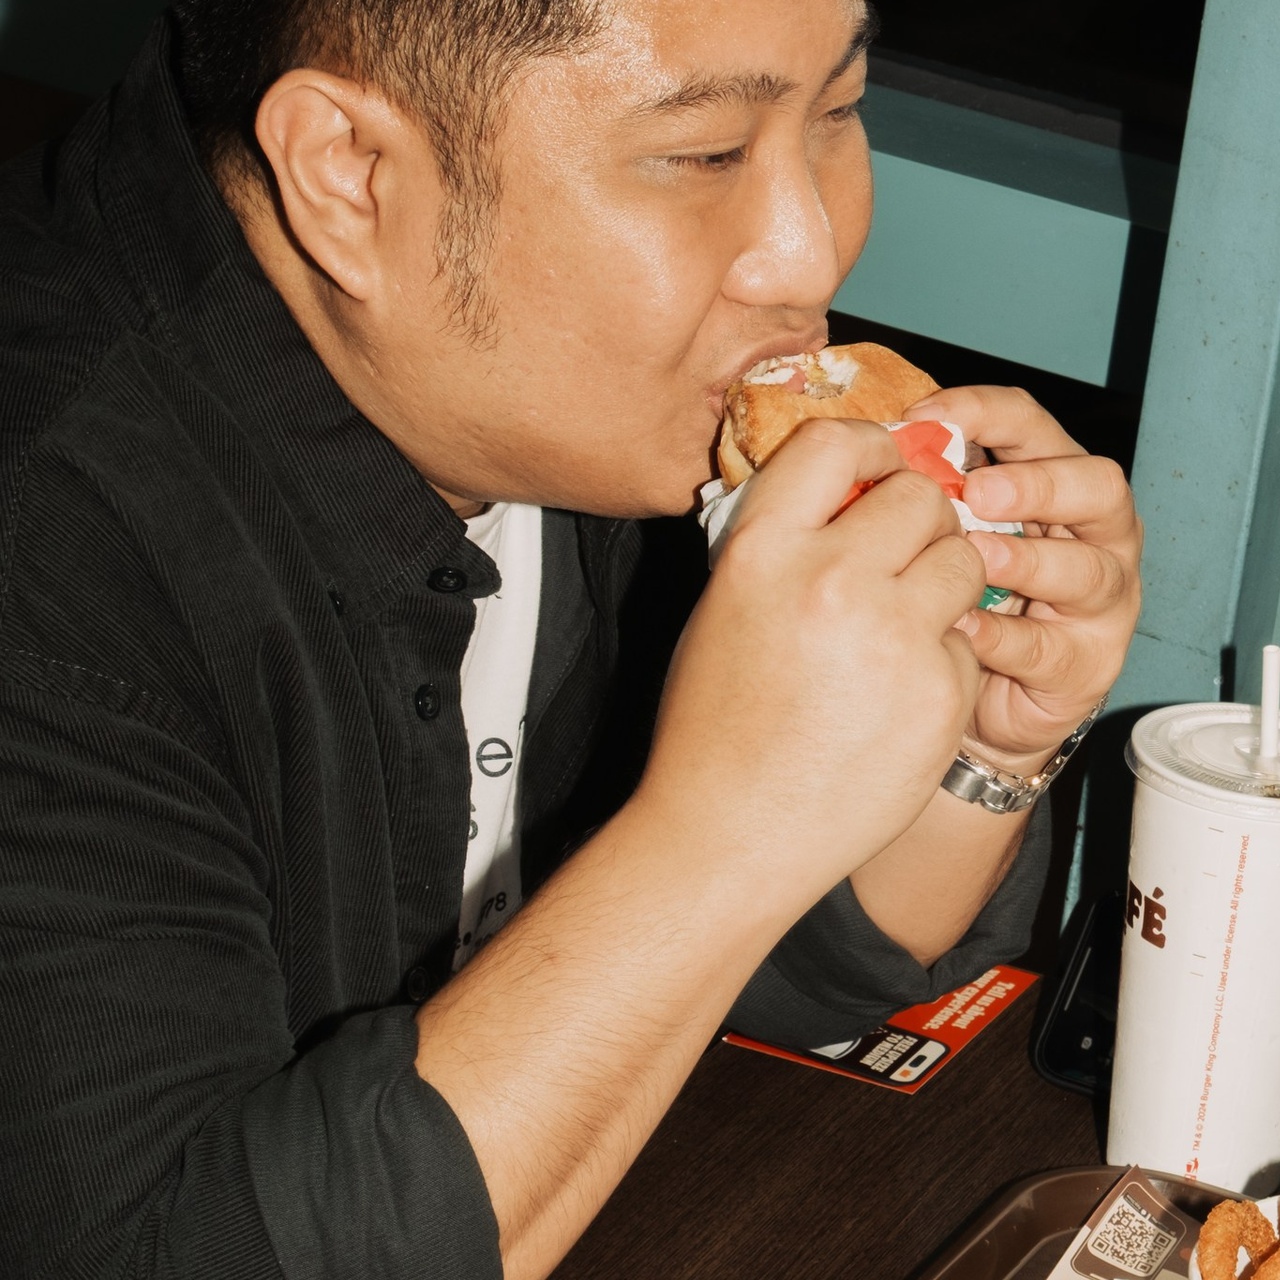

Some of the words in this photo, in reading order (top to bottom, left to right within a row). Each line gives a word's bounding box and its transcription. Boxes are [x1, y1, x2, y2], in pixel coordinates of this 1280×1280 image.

[1237, 834, 1250, 874] reserved.
[1232, 874, 1244, 899] rights
[1125, 880, 1167, 949] FÉ
[1229, 899, 1240, 911] All
[1225, 913, 1238, 944] license.
[1223, 945, 1232, 970] under
[986, 981, 1015, 999] Tell
[1217, 971, 1229, 992] Used
[951, 1004, 985, 1029] about
[886, 1032, 905, 1044] TO
[895, 1035, 919, 1053] FREE
[1208, 1012, 1223, 1052] Company
[1204, 1053, 1217, 1071] King
[1200, 1073, 1213, 1101] Burger
[1197, 1102, 1206, 1122] 2024
